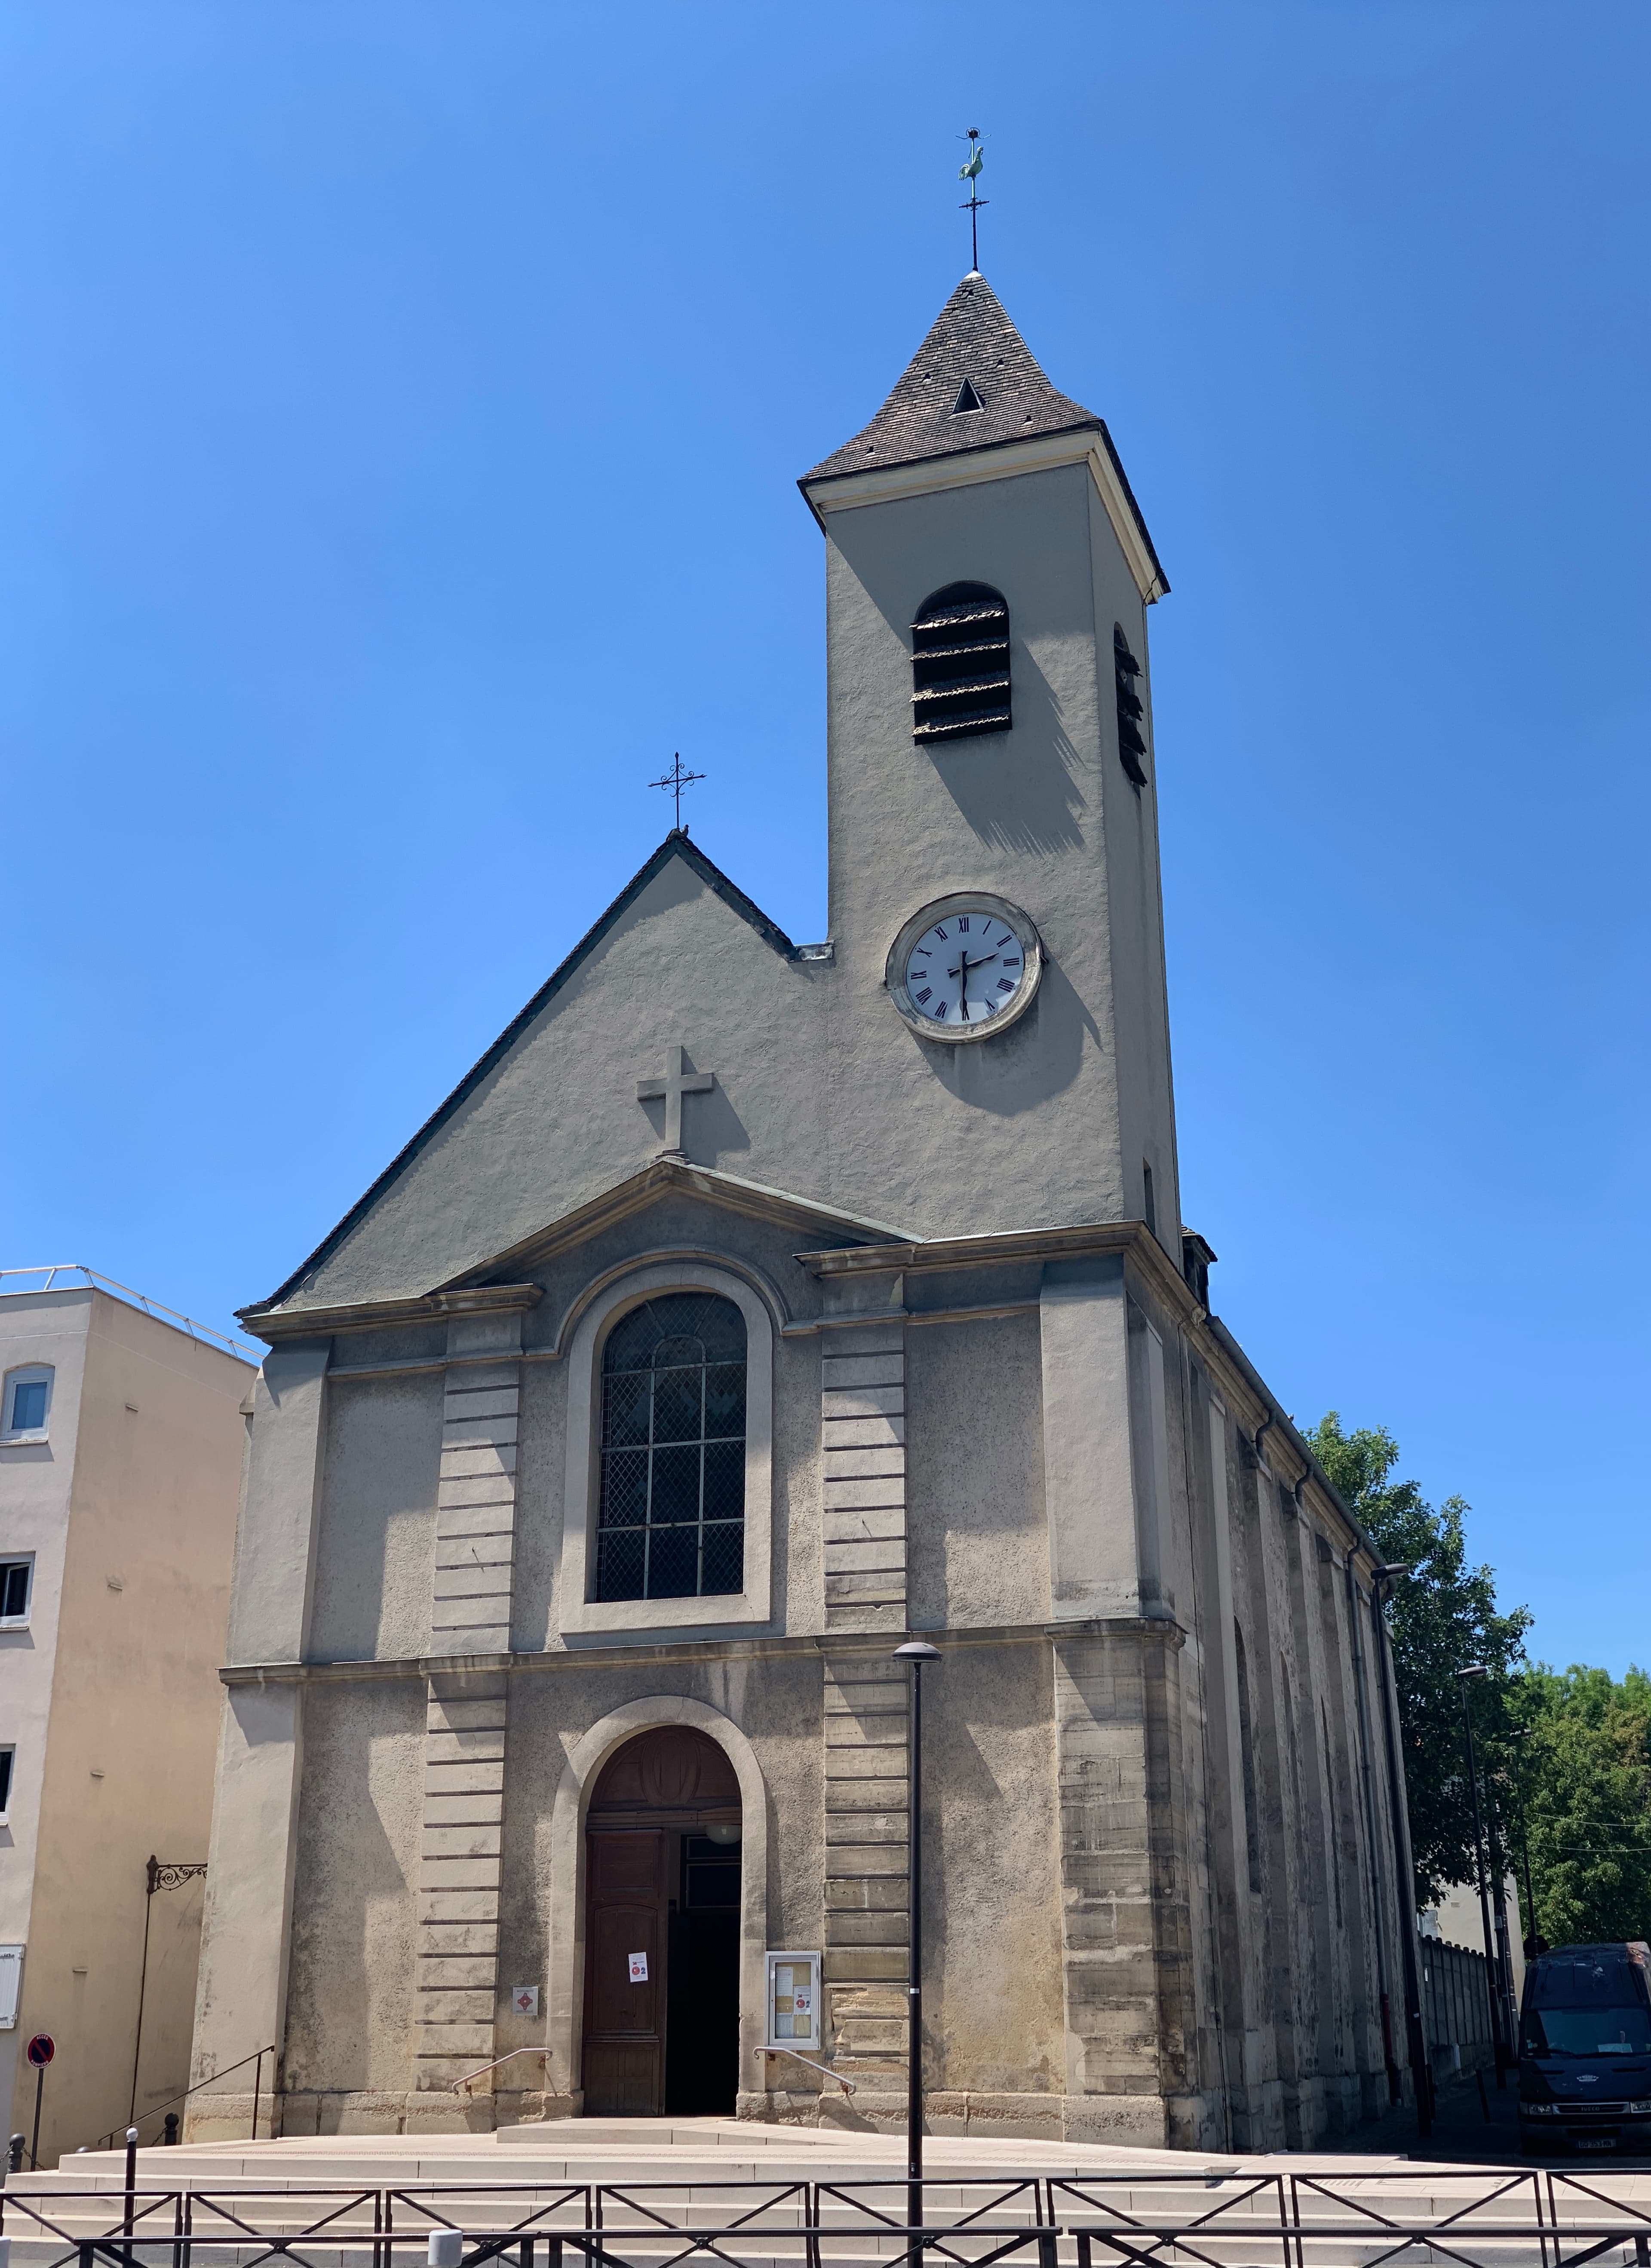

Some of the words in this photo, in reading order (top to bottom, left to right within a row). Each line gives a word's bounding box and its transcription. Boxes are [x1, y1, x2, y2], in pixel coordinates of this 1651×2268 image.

[958, 917, 969, 933] XII
[934, 926, 948, 942] XI
[997, 935, 1012, 947] II
[917, 947, 932, 957] X
[1003, 957, 1019, 967] III
[911, 970, 927, 979] IX
[997, 978, 1015, 992] IIII
[915, 987, 933, 1005] VIII
[935, 1001, 948, 1018] VII
[985, 998, 995, 1011] V
